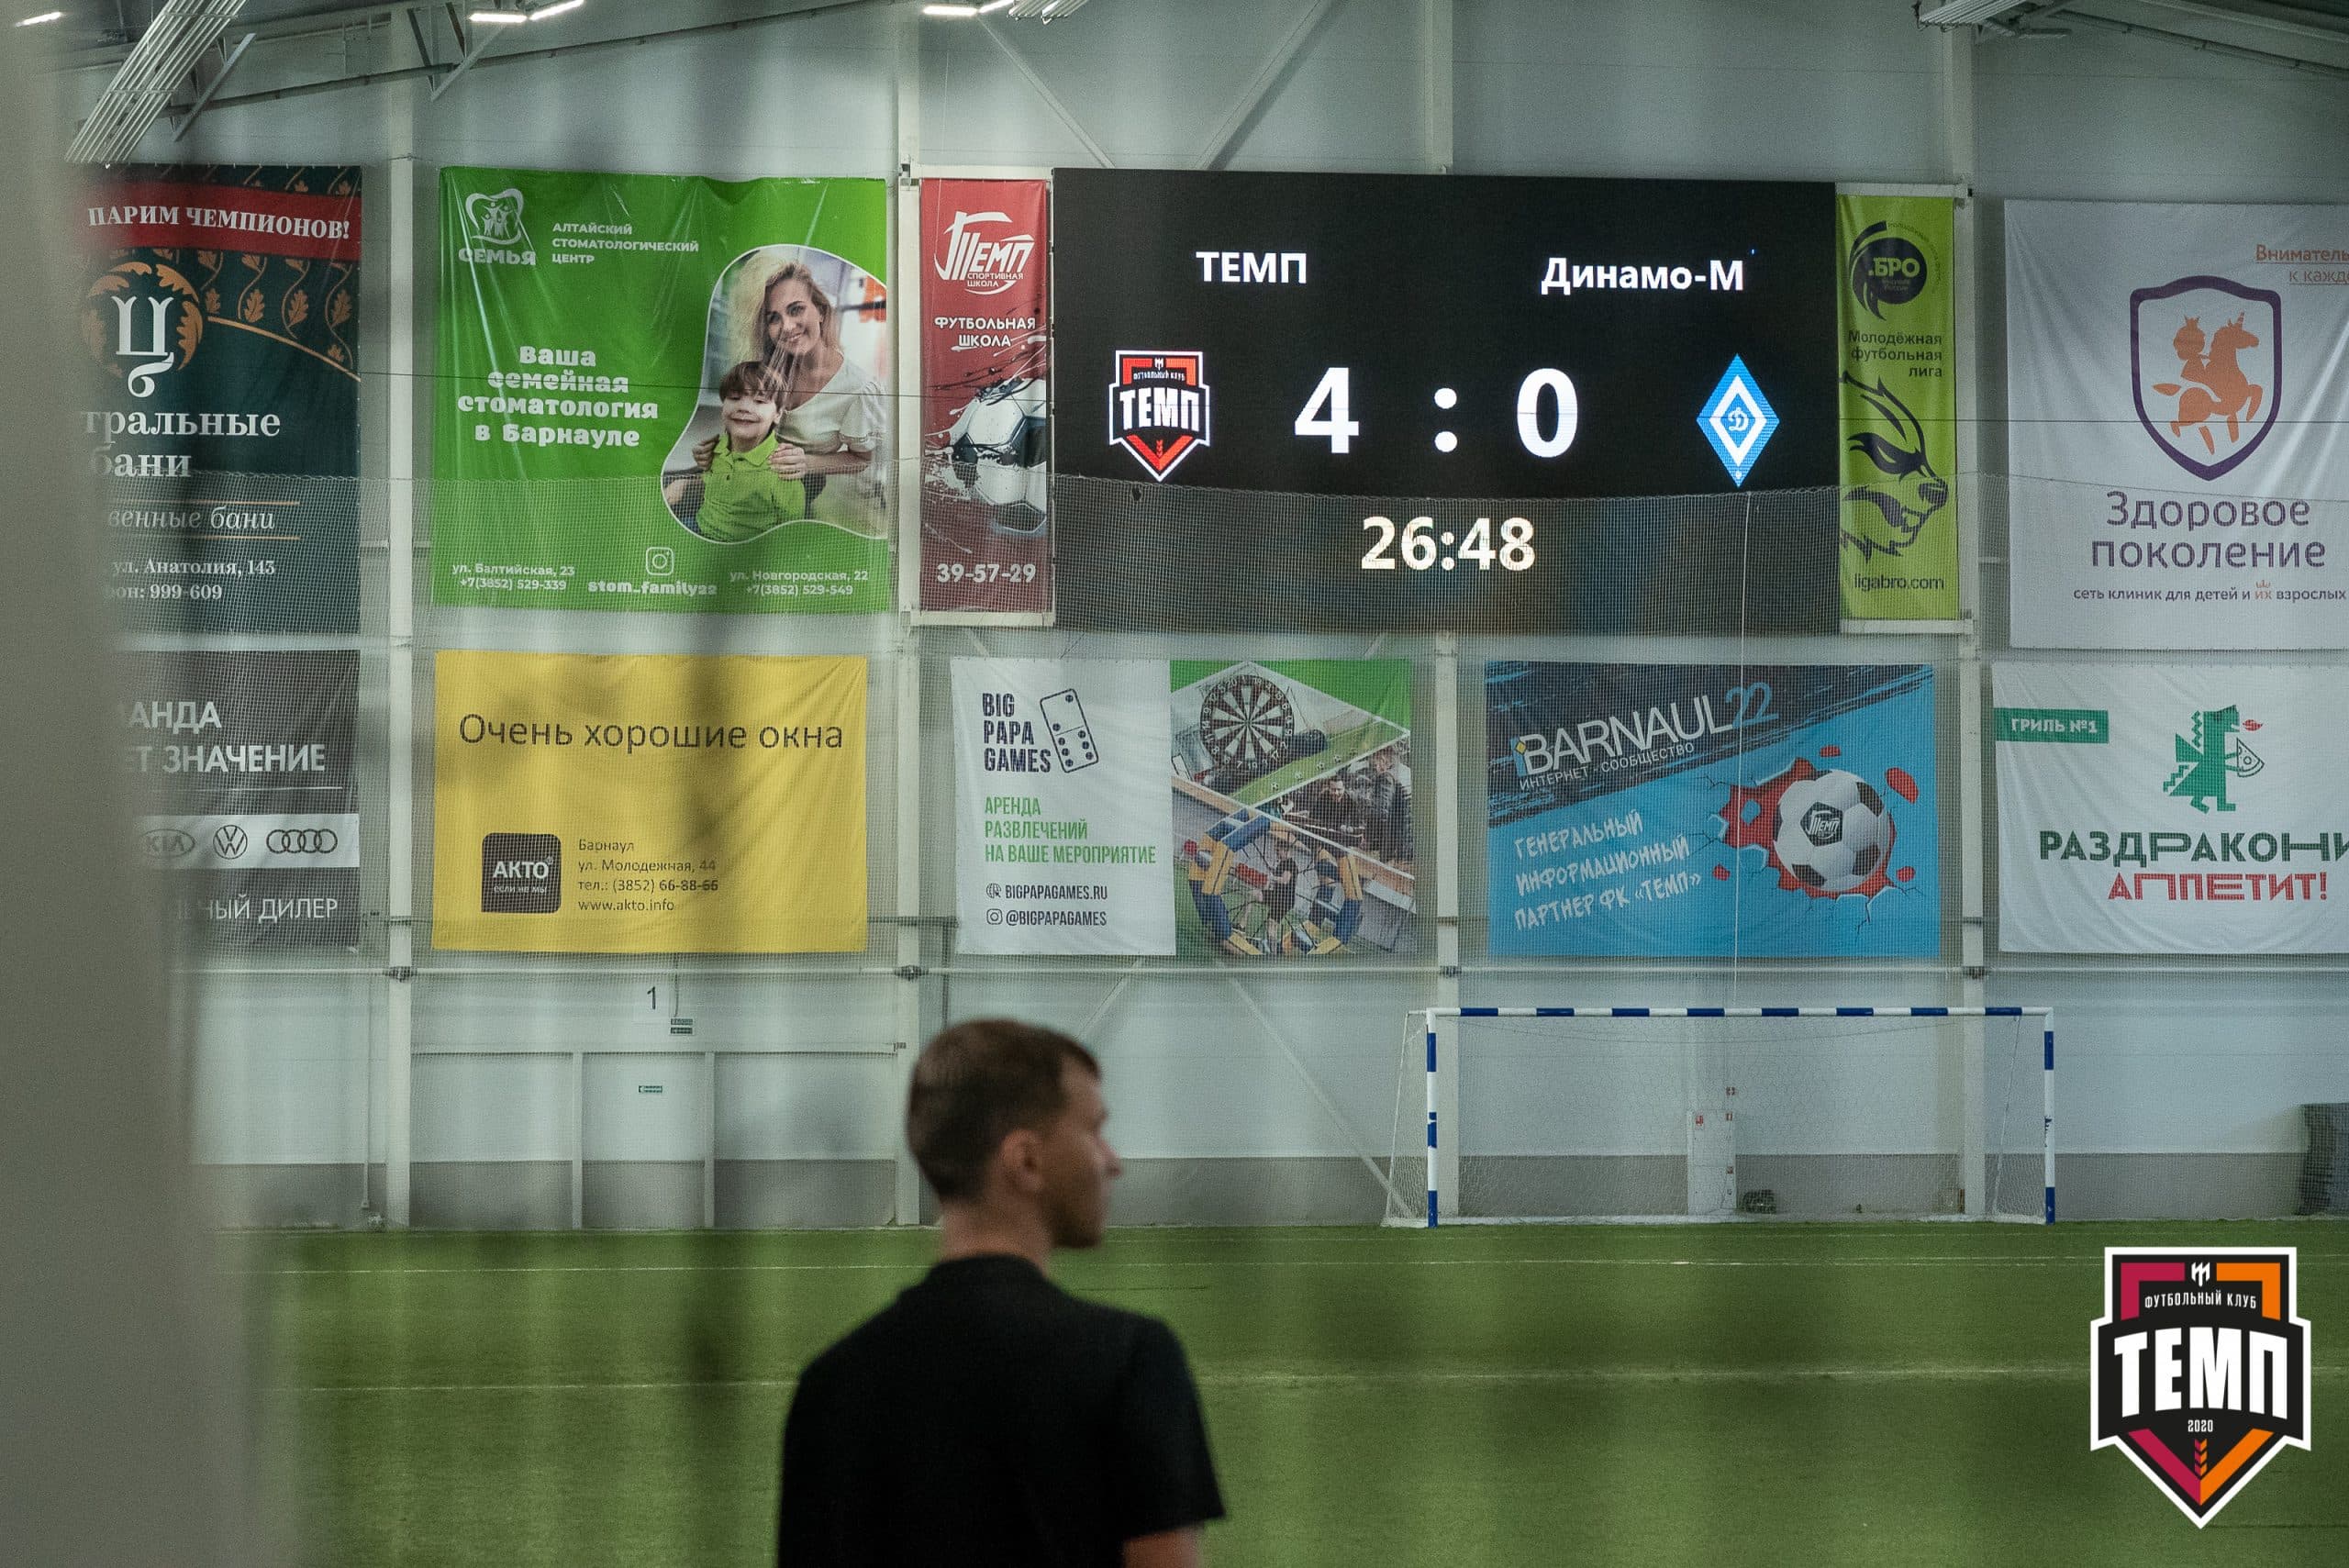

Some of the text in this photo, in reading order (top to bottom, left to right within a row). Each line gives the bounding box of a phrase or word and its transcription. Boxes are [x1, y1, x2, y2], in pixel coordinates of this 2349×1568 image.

[88, 206, 350, 239] ПАРИМ ЧЕМПИОНОВ!
[552, 222, 633, 235] АЛТАЙСКИЙ
[551, 238, 699, 252] СТОМАТОЛОГИЧЕСКИЙ
[459, 248, 537, 265] СЕМЬЯ
[551, 253, 595, 264] ЦЕНТР
[1196, 250, 1308, 284] ТЕМП
[1541, 257, 1744, 295] Динамо-М
[934, 317, 1036, 330] ФУТБОЛЬНАЯ
[959, 334, 1011, 347] ШКОЛА
[1848, 329, 1943, 346] Молодёжная
[519, 346, 596, 367] Ваша
[1851, 346, 1943, 361] футбольная
[487, 369, 629, 394] семейная
[1909, 366, 1943, 378] лига
[458, 395, 659, 419] стоматология
[1119, 386, 1199, 432] ТЕМП
[1294, 367, 1360, 454] 4
[1517, 368, 1578, 458] 0
[474, 423, 640, 450] в Барнауле
[209, 506, 275, 529] бани
[2106, 490, 2310, 531] Здоровое
[1361, 516, 1536, 572] 26:48
[2091, 540, 2326, 569] поколение
[144, 559, 241, 578] Анатолия,
[452, 563, 575, 577] ул. Балтийская, 23
[729, 571, 869, 583] ул. Новгородская, 22
[937, 563, 1036, 583] 39-57-29
[150, 584, 223, 600] 999-609
[460, 578, 567, 591] +7(3852) 529-339
[1854, 573, 1944, 592] ligabro.com
[2074, 587, 2346, 603] сеть клиник для детей и их взрослых
[982, 693, 1015, 717] BIG
[460, 713, 843, 754] Очень хорошие окна
[984, 720, 1035, 745] PAPA
[2011, 718, 2065, 733] ГРИЛЬ
[162, 744, 325, 773] ЗНАЧЕНИЕ
[984, 748, 1052, 773] GAMES
[1520, 765, 1588, 791] ИНТЕРНЕТ
[1600, 742, 1695, 773] СООБЩЕСТВО
[985, 796, 1041, 817] АРЕНДА
[985, 817, 1087, 840] РАЗВЛЕЧЕНИЙ
[1514, 808, 1643, 860] ГЕНЕРАЛЬНЫЙ
[578, 839, 634, 853] Барнаул
[985, 844, 1156, 864] НА ВАШЕ МЕРОПРИЯТИЕ
[578, 861, 596, 873] ул.
[602, 860, 695, 873] Молодежная,
[1516, 833, 1690, 896] ИНФОРМАЦИОННЫЙ
[578, 881, 608, 891] тел.:
[613, 879, 655, 894] (3852)
[1006, 884, 1108, 900] BIGPAPAGAMES.RU
[2108, 872, 2328, 901] АППЕТИТ!
[258, 897, 338, 924] ДИЛЕР
[578, 898, 674, 911] www.akto.info
[1514, 871, 1702, 931] ПАРТНЕР ФК «ТЕМП»
[1006, 910, 1107, 927] @BIGPAPAGAMES
[647, 986, 656, 1010] 1
